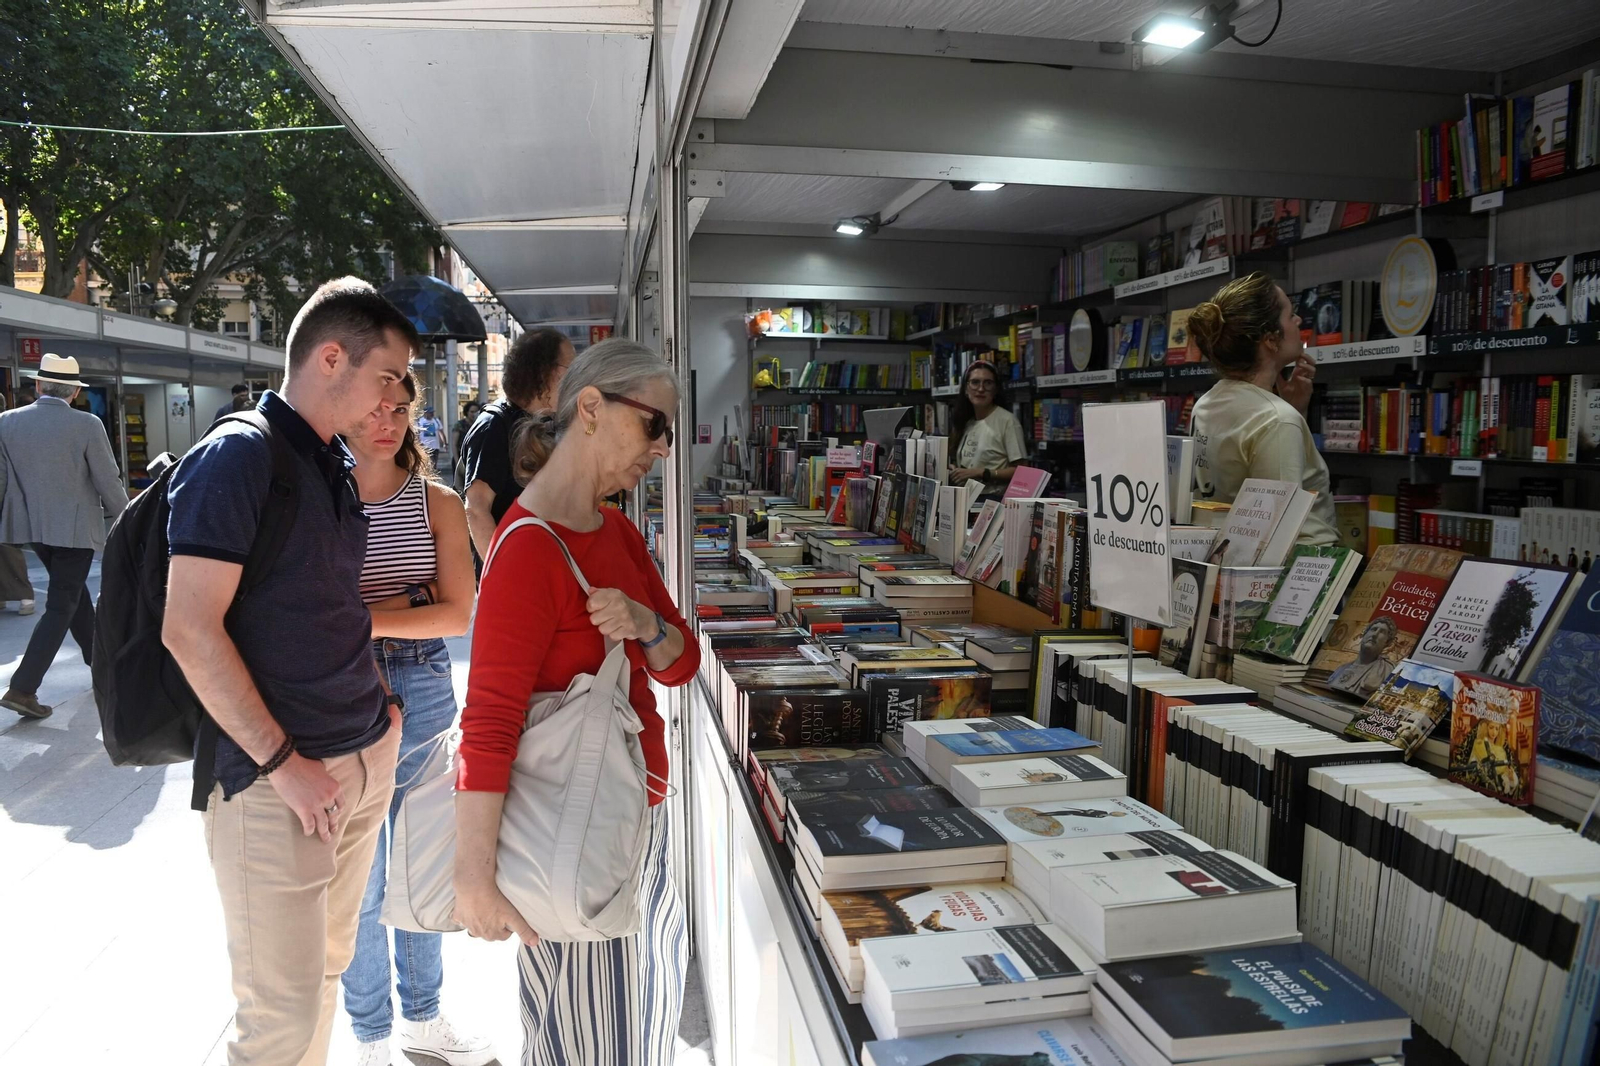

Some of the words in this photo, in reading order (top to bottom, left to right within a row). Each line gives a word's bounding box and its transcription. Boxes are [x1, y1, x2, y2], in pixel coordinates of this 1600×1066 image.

[1537, 261, 1557, 269] CARMEN
[1190, 266, 1215, 277] descuento
[1537, 294, 1555, 302] NOVIA
[1452, 340, 1472, 351] 10%
[1473, 337, 1488, 349] de
[1488, 334, 1547, 349] descuento
[1332, 350, 1348, 359] 10%
[1348, 348, 1357, 357] de
[1358, 345, 1400, 357] descuento
[1091, 473, 1164, 527] 10%
[1253, 499, 1262, 508] LA
[1526, 495, 1553, 507] TODO
[1235, 508, 1271, 520] BIBLIOTECA
[1229, 524, 1260, 538] CÓRDOBA
[1093, 528, 1106, 545] de
[1108, 530, 1165, 556] descuento
[1073, 537, 1081, 583] MALDITA
[1181, 551, 1193, 560] LA
[1296, 561, 1330, 569] DICCIONARIO
[1291, 575, 1321, 583] CORDOBESA
[1368, 581, 1388, 589] JUAN
[1183, 583, 1195, 595] LUZ
[1251, 582, 1262, 590] El
[1392, 581, 1437, 599] Ciudades
[1248, 590, 1257, 598] de
[1354, 591, 1380, 599] ESLAVA
[1349, 599, 1377, 608] GALÁN
[1417, 598, 1428, 606] de
[1428, 600, 1436, 609] la
[1455, 596, 1489, 605] MANUEL
[1380, 596, 1430, 621] Bética
[1451, 603, 1485, 612] GARCÍA
[1447, 610, 1482, 620] PARODY
[1431, 621, 1478, 643] Paseos
[1454, 624, 1481, 633] NUEVOS
[1422, 638, 1469, 659] Córdoba
[821, 726, 833, 743] LAS
[1115, 801, 1133, 811] NOVIO
[1138, 815, 1161, 828] MUNDO
[942, 899, 966, 917] FUGAS
[952, 891, 988, 922] VIOLENCIAS
[1299, 969, 1316, 981] Carlos
[1231, 958, 1257, 972] LAS
[1249, 972, 1308, 1015] ESTRELLAS
[1255, 960, 1271, 970] EL
[1268, 970, 1307, 997] PULSO
[1299, 995, 1323, 1008] DE
[1037, 1030, 1073, 1063] CLAVARSE
